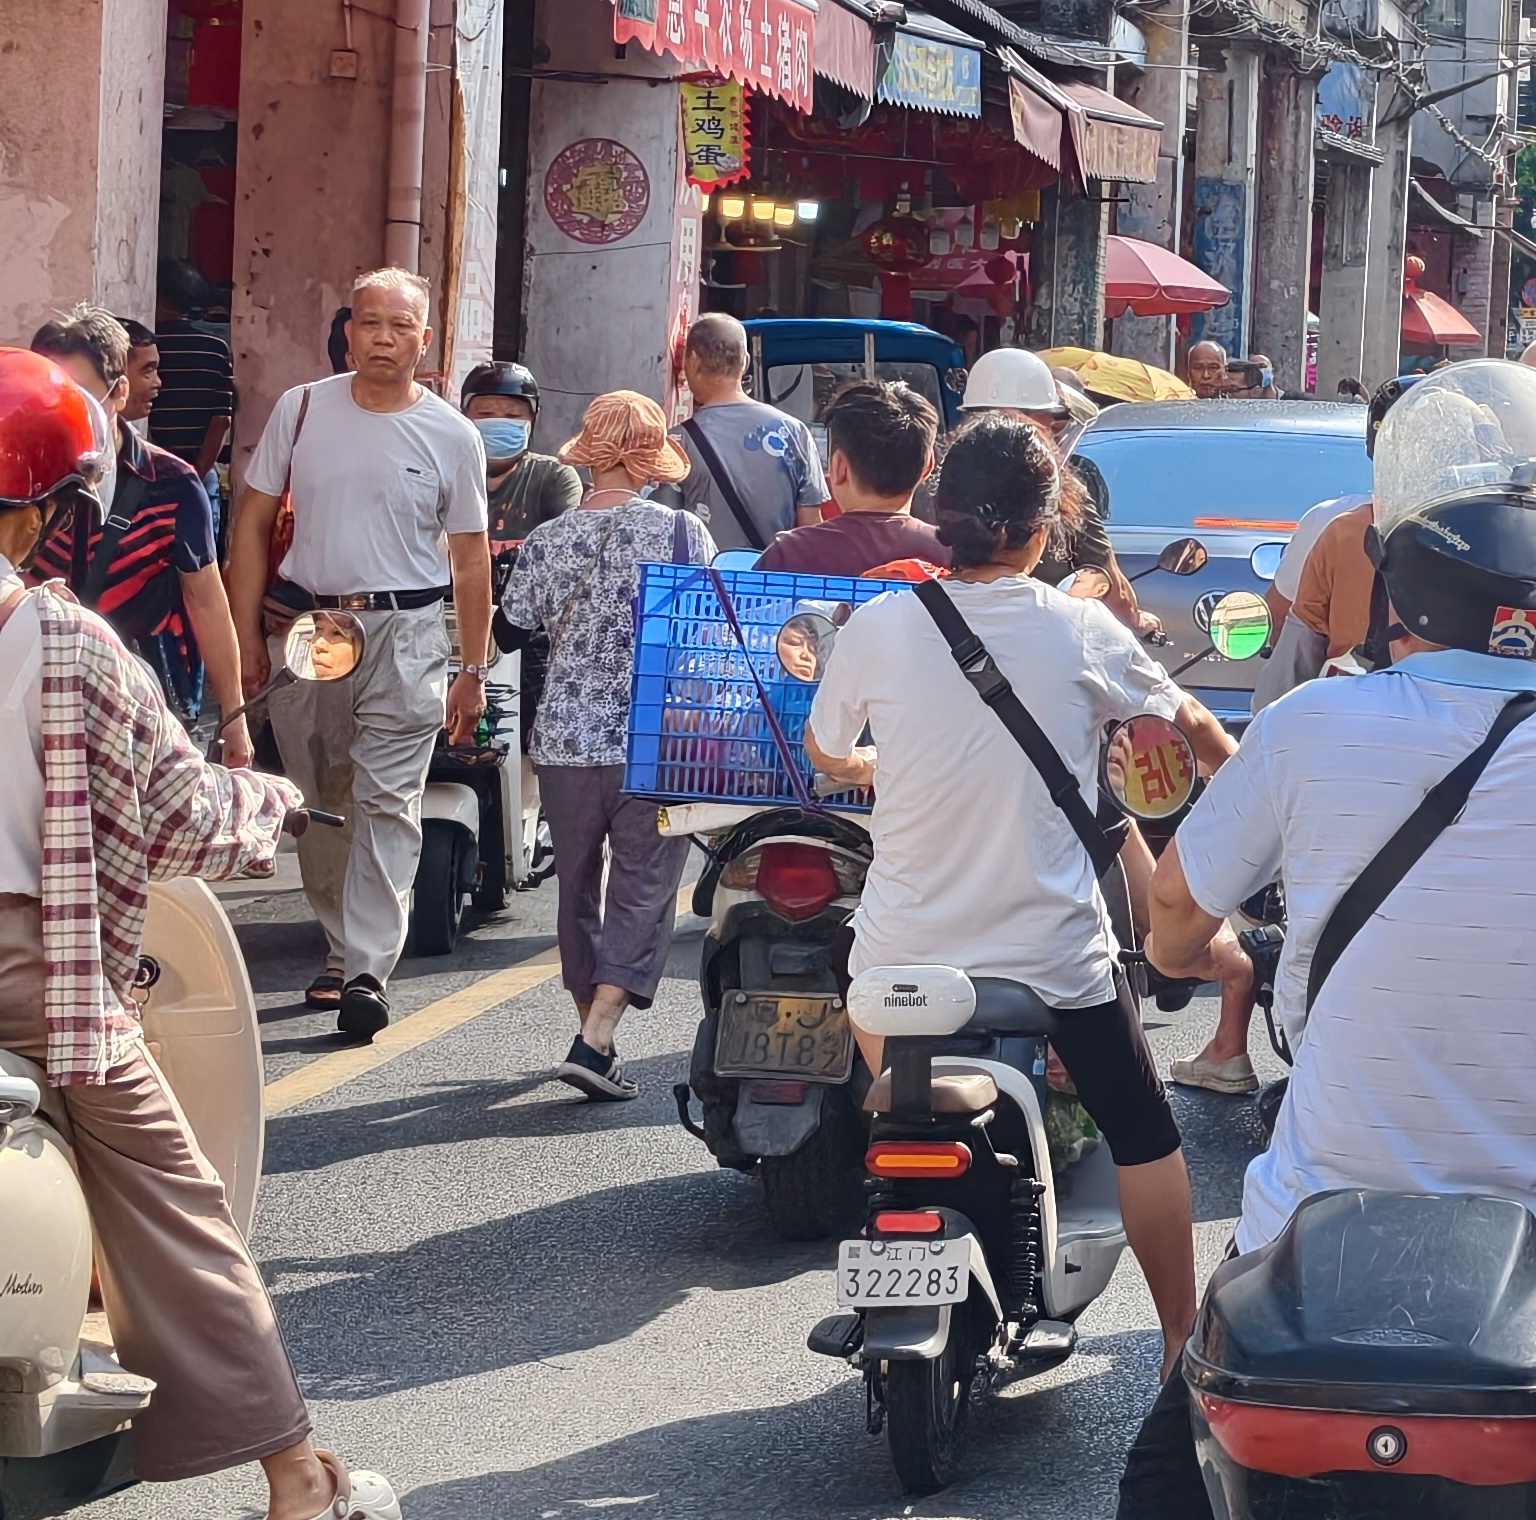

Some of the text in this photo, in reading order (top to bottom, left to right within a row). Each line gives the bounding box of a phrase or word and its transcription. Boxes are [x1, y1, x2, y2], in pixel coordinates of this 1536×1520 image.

[688, 90, 727, 170] 土鸡蛋
[884, 993, 929, 1008] ninebot
[886, 1246, 926, 1262] 江门
[845, 1265, 960, 1298] 322283
